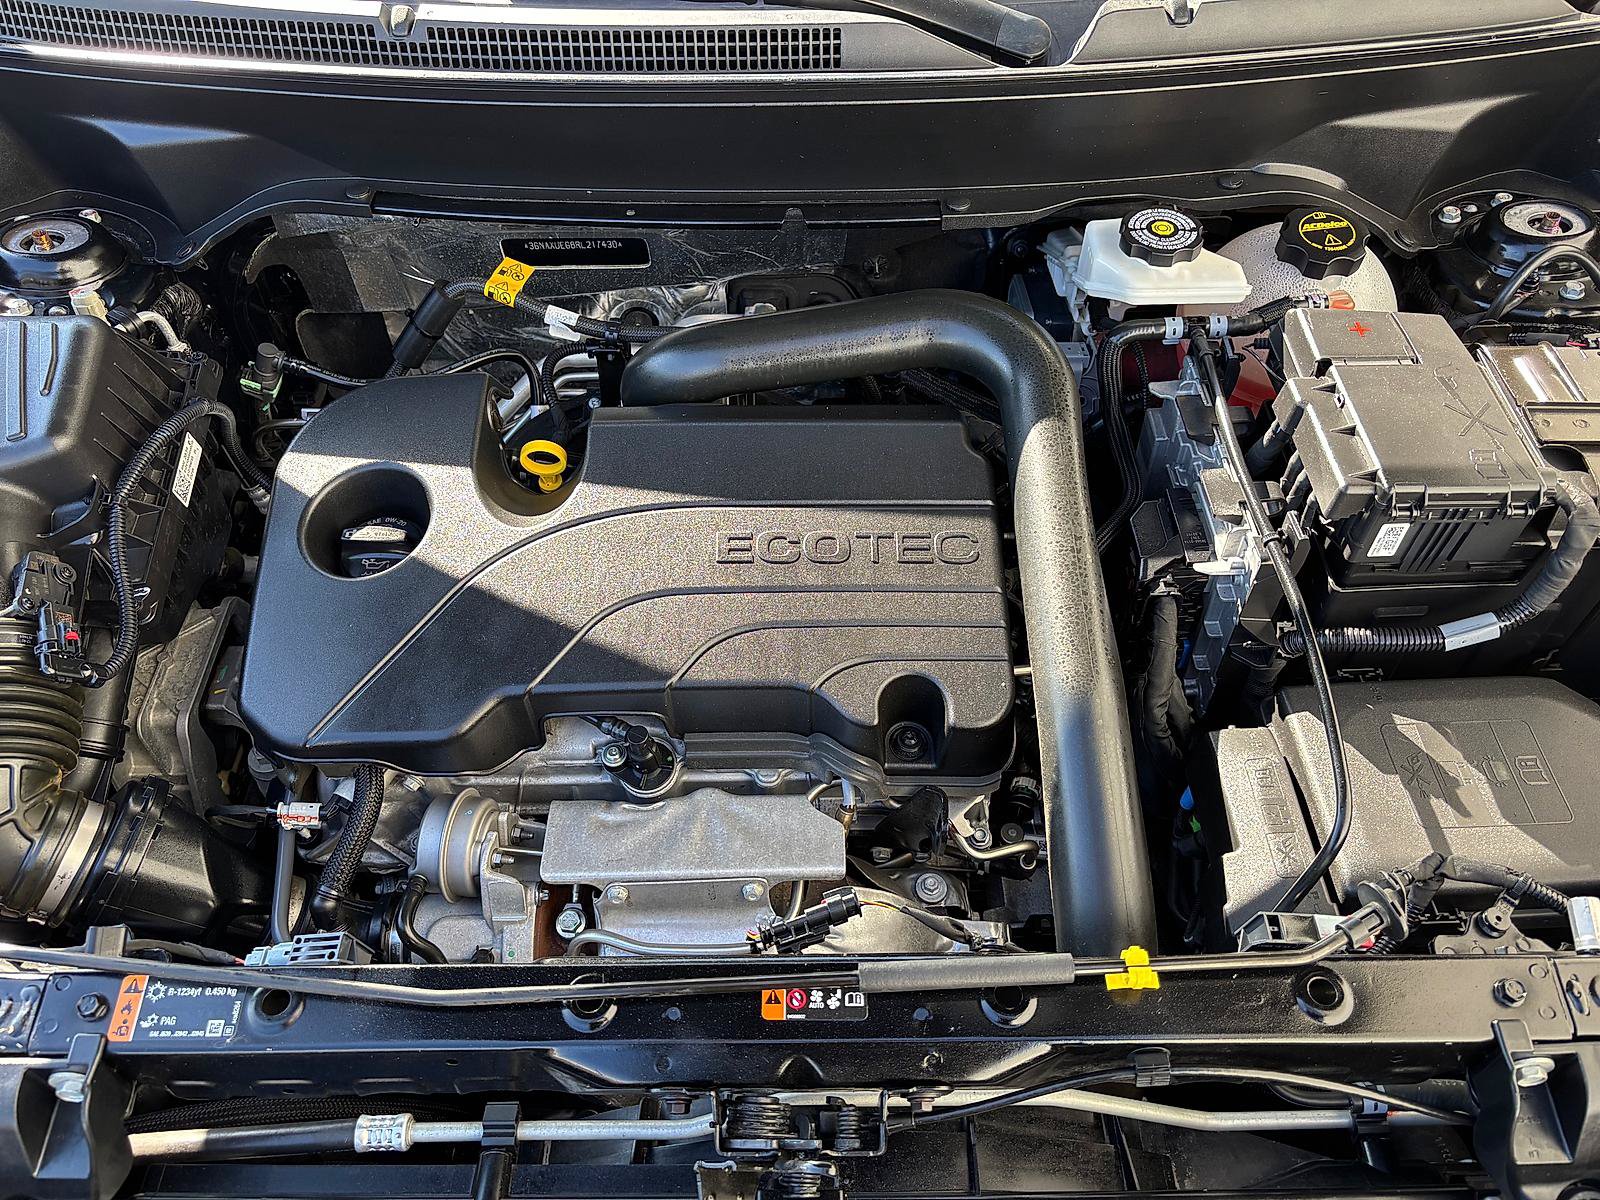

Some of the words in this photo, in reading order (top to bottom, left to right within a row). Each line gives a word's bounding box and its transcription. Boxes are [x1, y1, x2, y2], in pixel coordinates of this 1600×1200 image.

[1302, 220, 1348, 230] ACDelco
[384, 517, 407, 527] 0W-20
[715, 530, 980, 565] ECOTEC
[167, 987, 203, 998] R-1234yf
[205, 986, 226, 996] 0.450
[226, 987, 238, 997] kg
[160, 1016, 177, 1026] PAG
